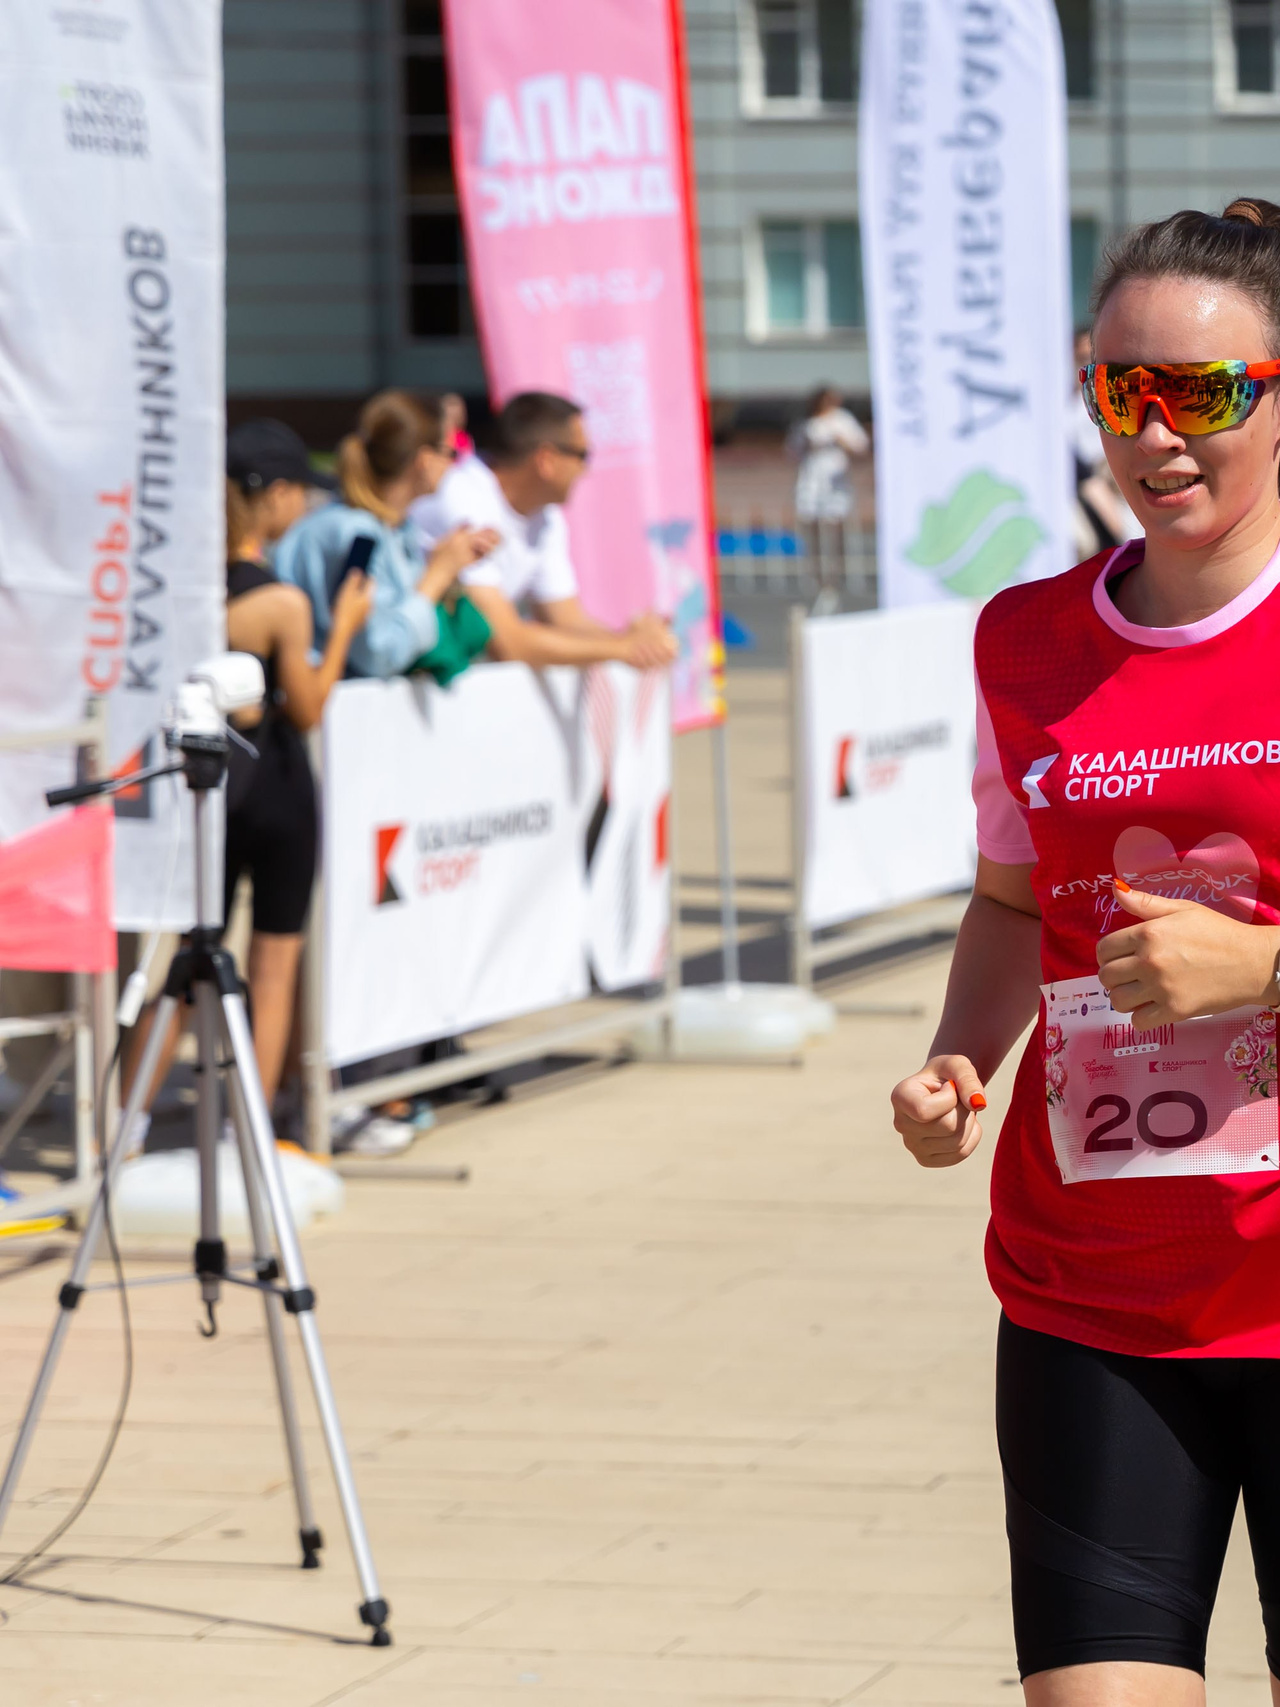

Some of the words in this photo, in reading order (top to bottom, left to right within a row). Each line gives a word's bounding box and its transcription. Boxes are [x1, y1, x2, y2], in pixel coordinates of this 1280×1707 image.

[1065, 773, 1159, 801] СПОРТ
[1052, 873, 1115, 899] клуб
[1084, 1090, 1208, 1154] 20
